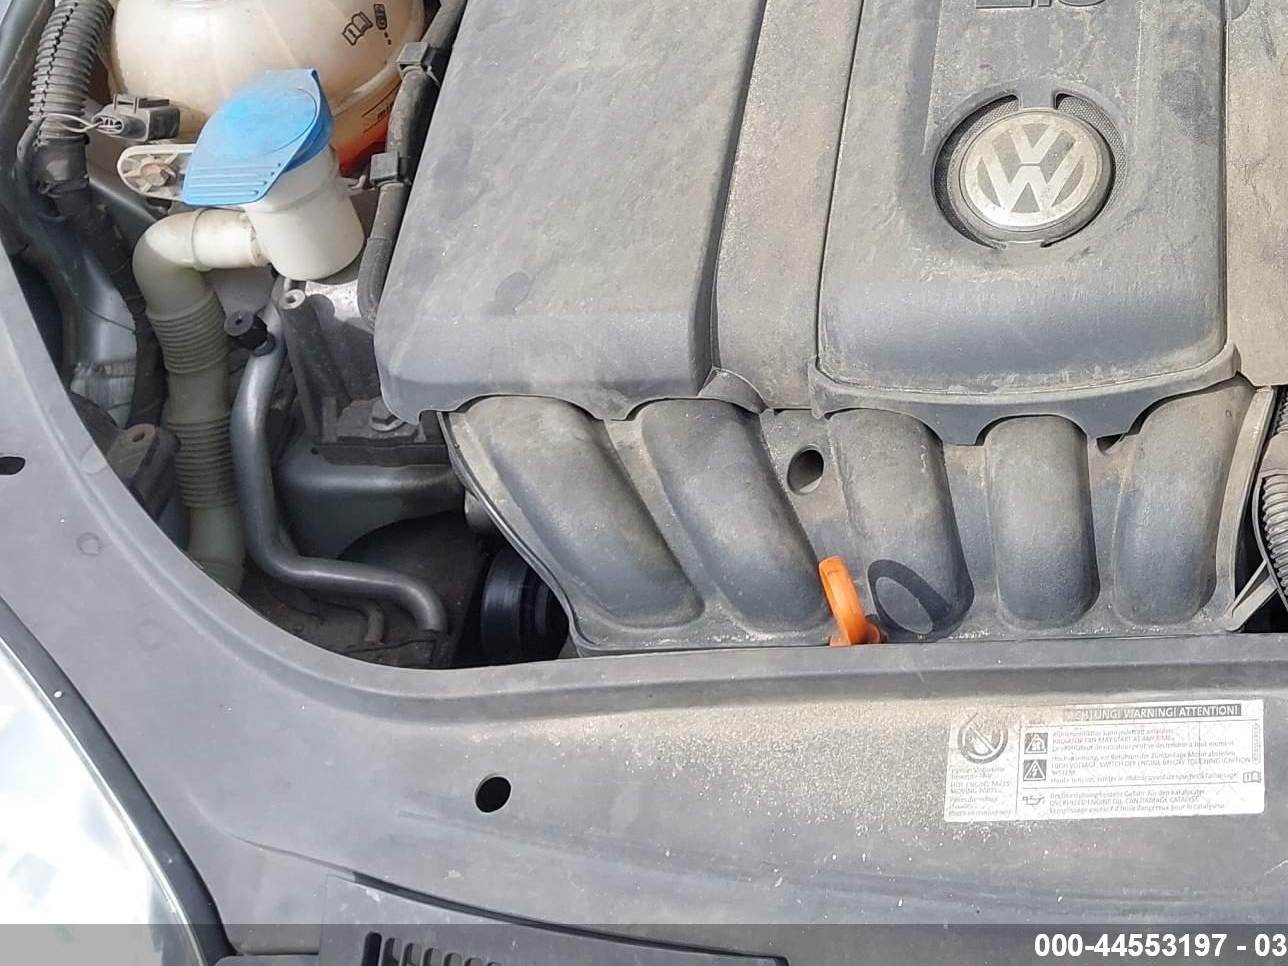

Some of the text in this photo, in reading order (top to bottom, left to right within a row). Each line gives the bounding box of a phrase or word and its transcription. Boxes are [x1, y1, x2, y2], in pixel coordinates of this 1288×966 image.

[965, 114, 1098, 227] VW
[1122, 706, 1177, 721] WARNING!
[1178, 704, 1239, 717] ATTENTION!
